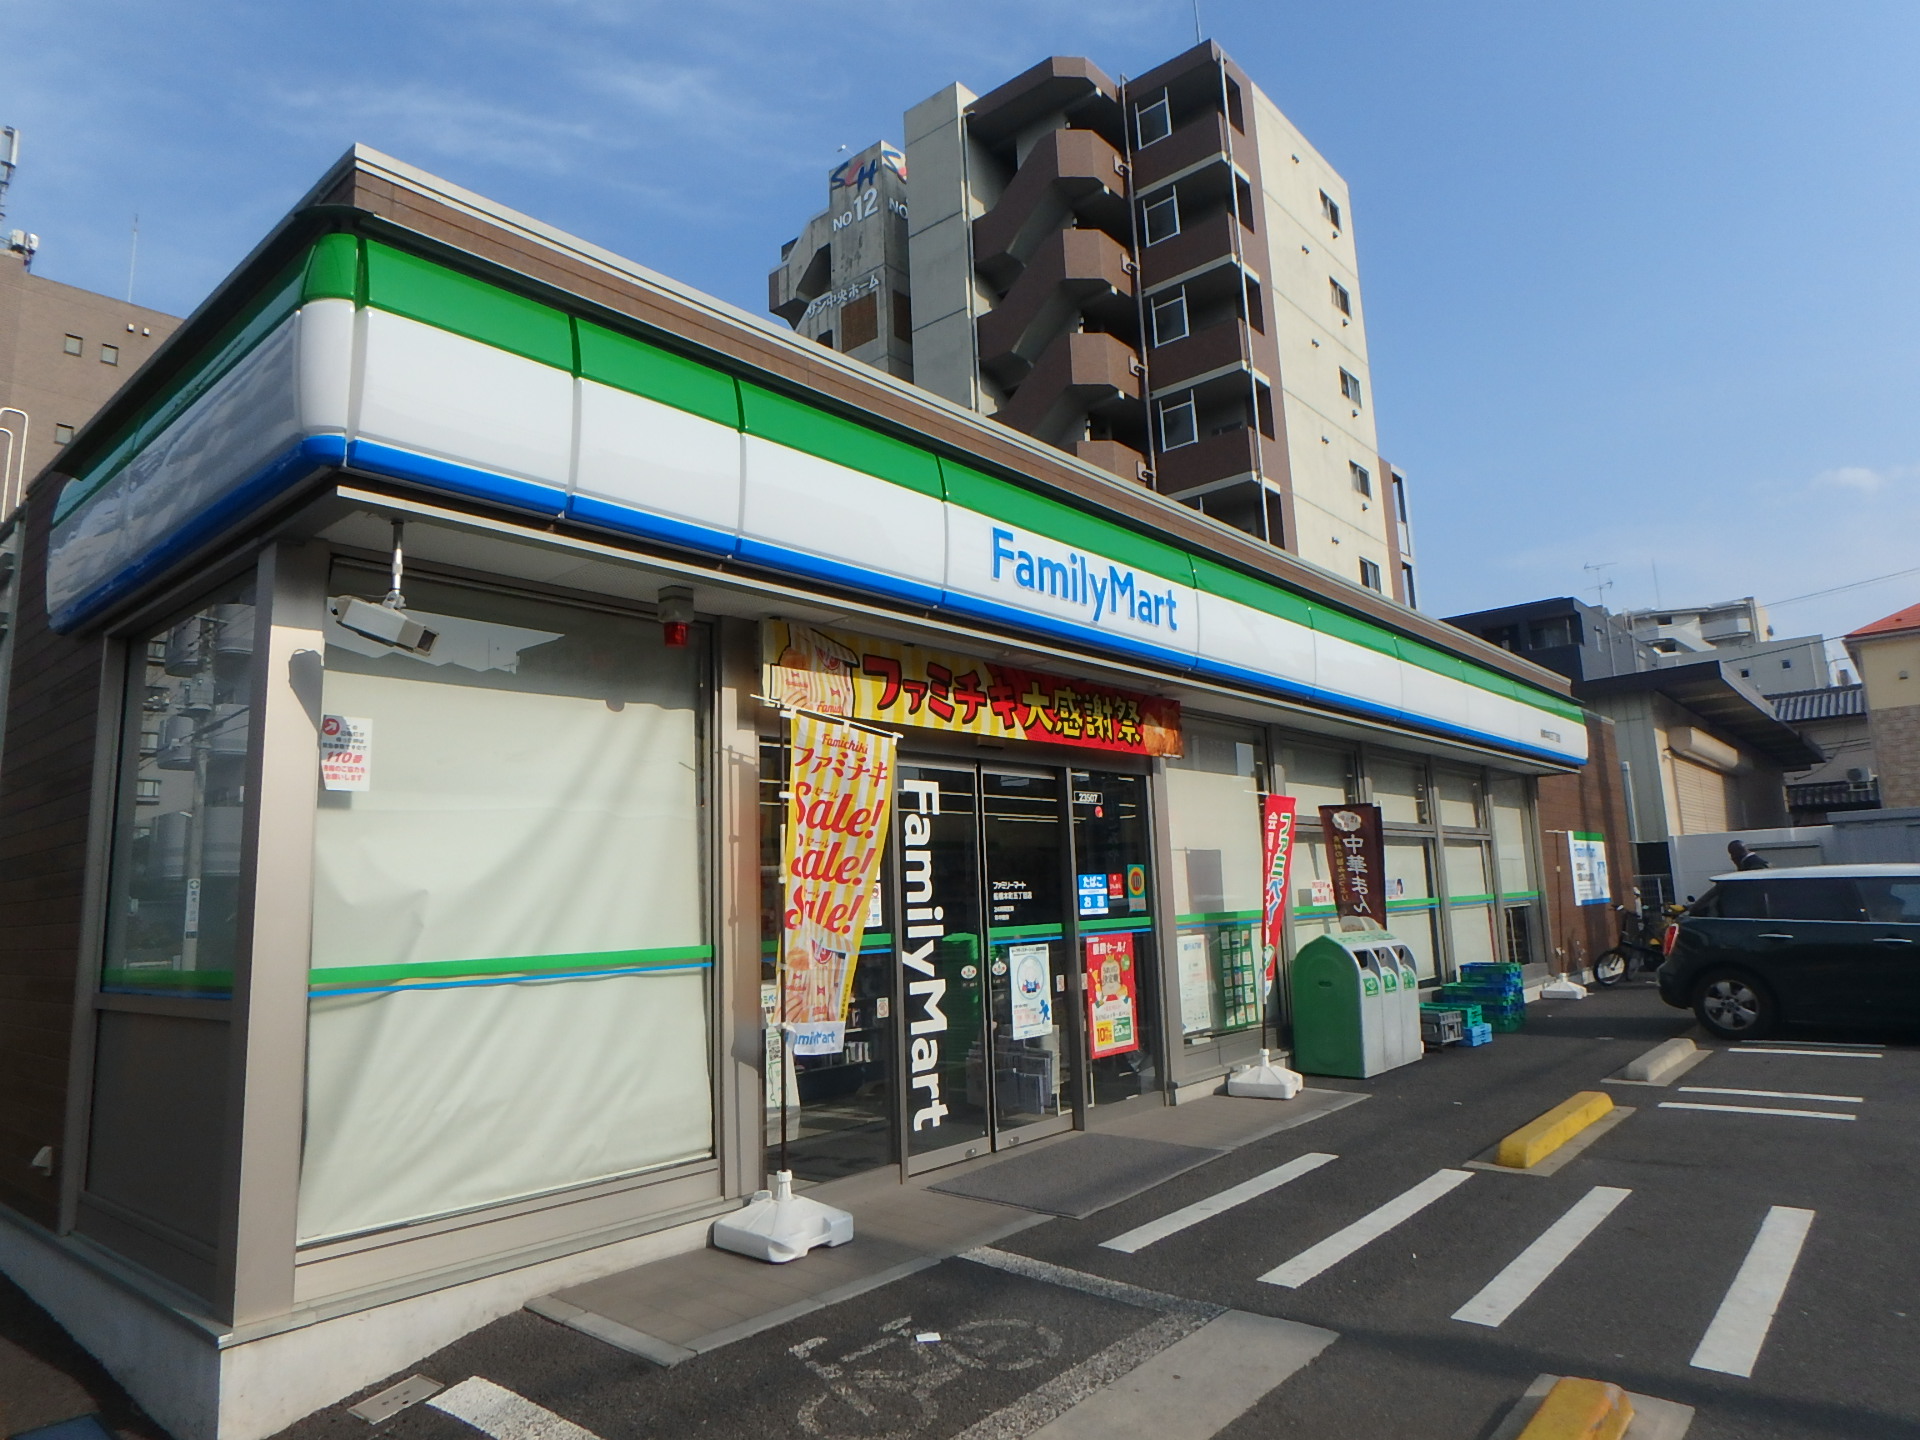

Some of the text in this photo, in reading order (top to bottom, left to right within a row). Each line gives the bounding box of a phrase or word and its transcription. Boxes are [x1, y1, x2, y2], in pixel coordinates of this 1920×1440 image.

[833, 187, 879, 232] NO 12
[992, 527, 1178, 632] FamilyMart
[863, 653, 1143, 744] ファミチキ大感謝祭
[794, 745, 888, 787] ファミチキ
[822, 734, 868, 754] Famichiki
[814, 787, 840, 799] セール
[1082, 876, 1103, 888] たばこ
[1343, 834, 1372, 914] 中華まん
[902, 779, 949, 1132] FamilyMart
